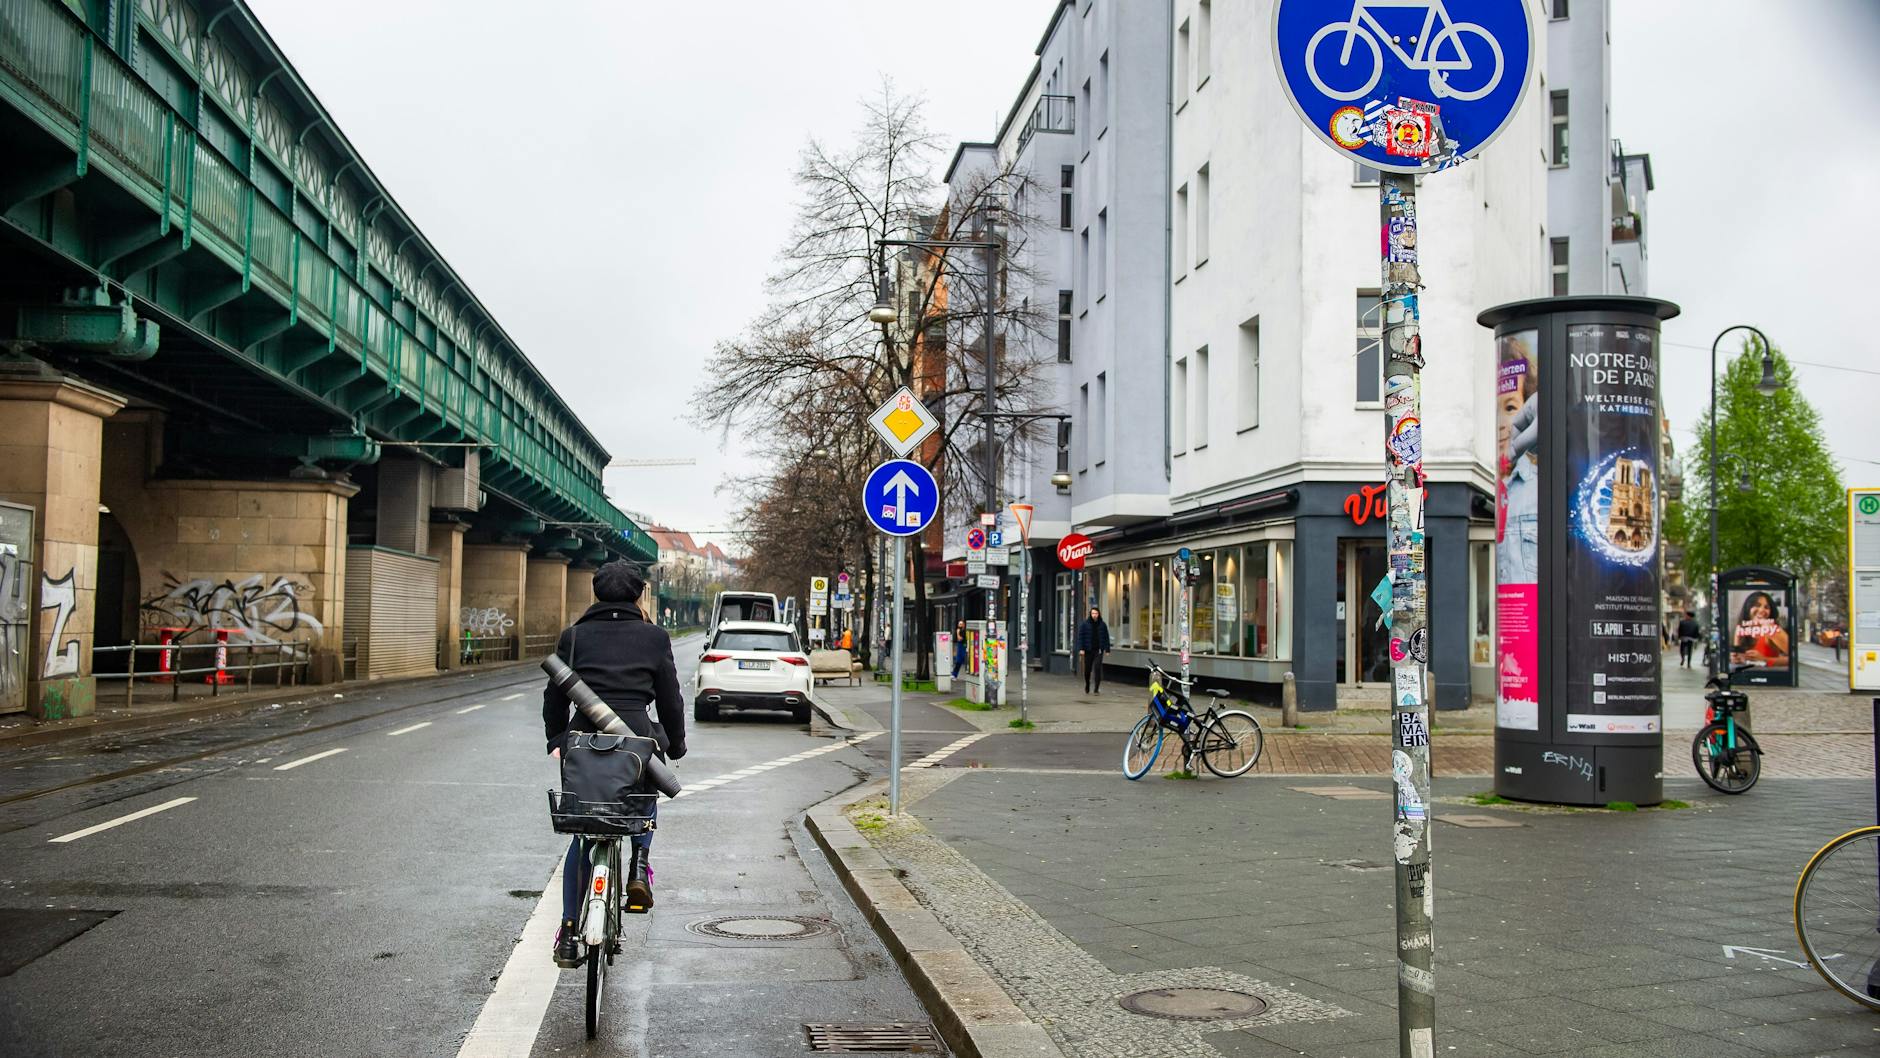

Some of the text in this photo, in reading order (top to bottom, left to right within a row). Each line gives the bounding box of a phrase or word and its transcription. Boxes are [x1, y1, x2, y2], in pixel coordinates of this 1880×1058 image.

[1593, 369, 1619, 384] DE
[1584, 394, 1642, 405] WELTREISE
[992, 533, 998, 545] P
[1060, 540, 1093, 562] Viani
